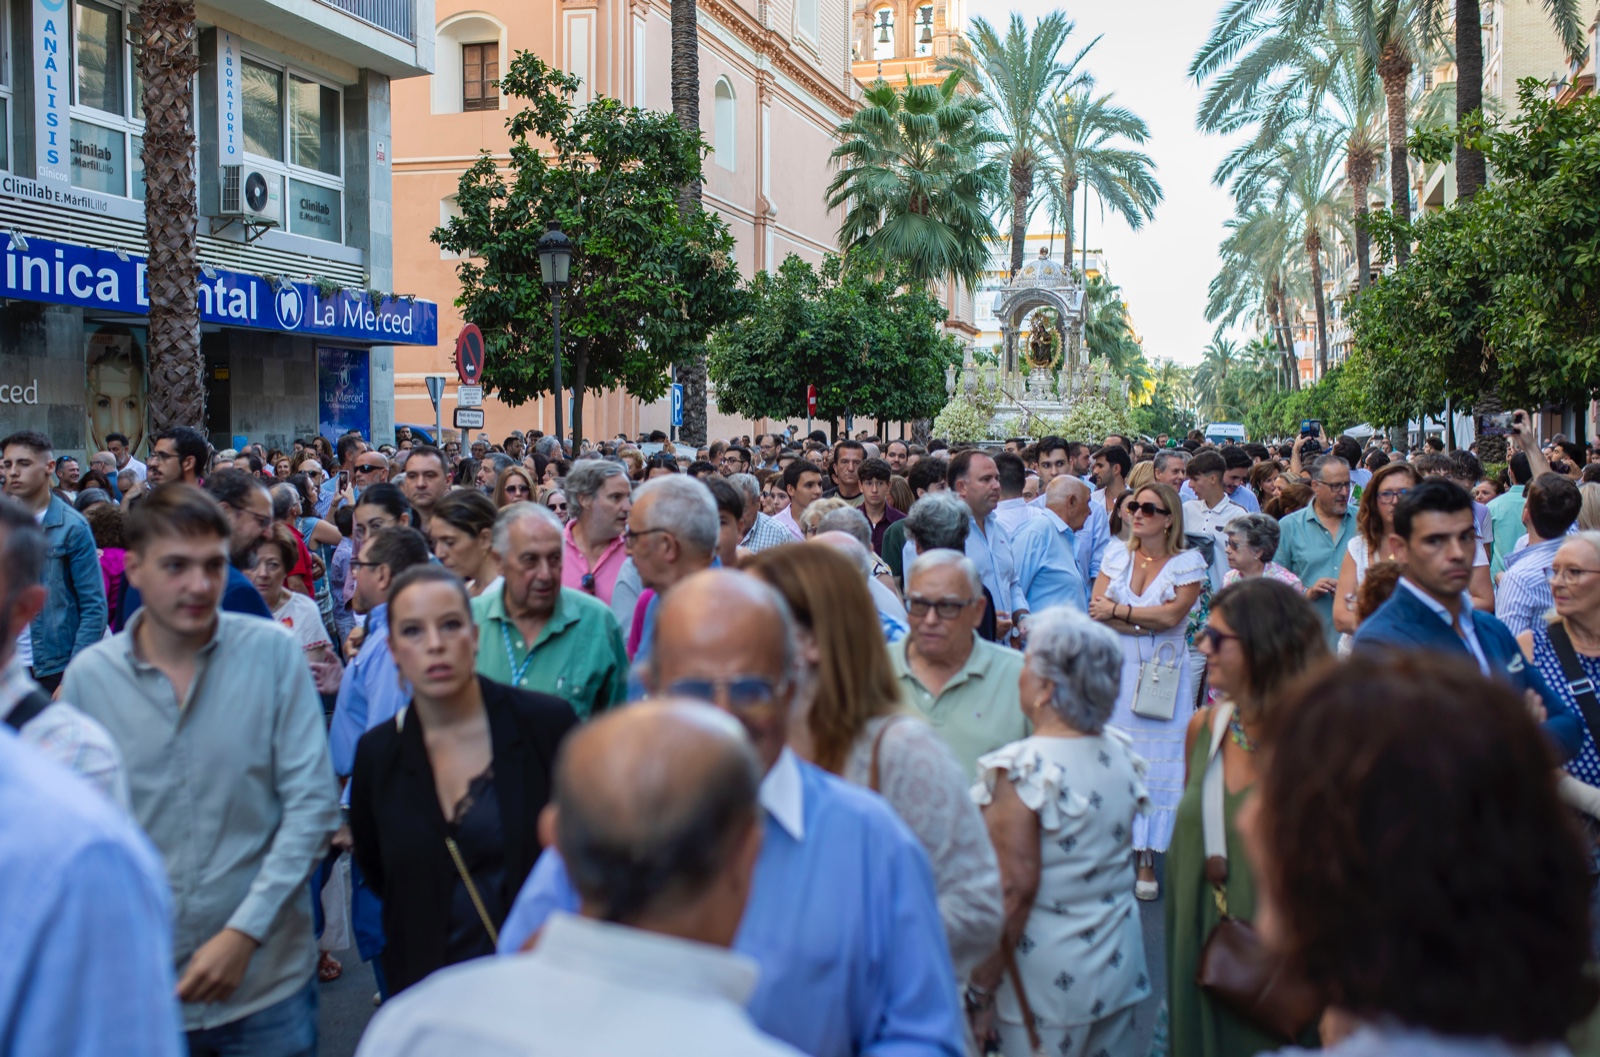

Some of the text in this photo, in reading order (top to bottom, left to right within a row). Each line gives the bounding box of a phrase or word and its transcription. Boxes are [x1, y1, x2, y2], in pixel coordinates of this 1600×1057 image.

[44, 19, 59, 164] ANÁLISIS
[225, 34, 235, 155] LABORATORIO
[2, 177, 53, 200] Clinilab
[38, 165, 69, 182] Clínicos
[300, 198, 330, 215] Clinilab
[137, 262, 257, 320] ntal
[313, 295, 412, 335] La Merced
[324, 390, 364, 403] La Merced
[674, 388, 681, 422] P
